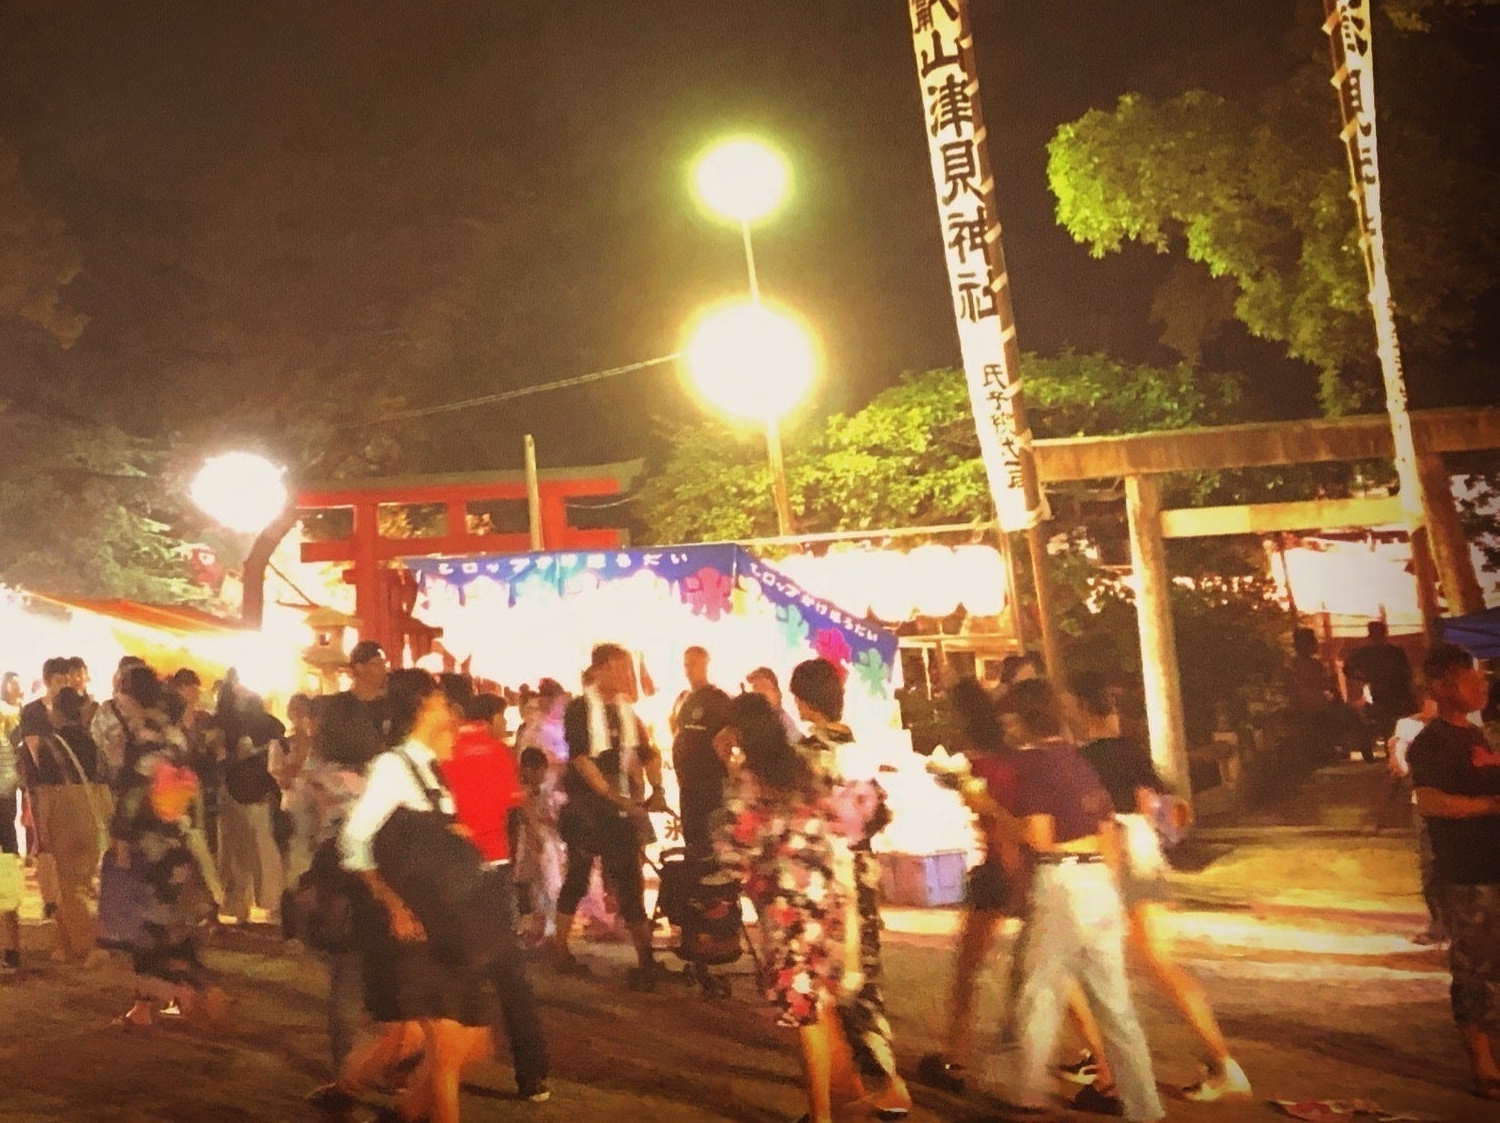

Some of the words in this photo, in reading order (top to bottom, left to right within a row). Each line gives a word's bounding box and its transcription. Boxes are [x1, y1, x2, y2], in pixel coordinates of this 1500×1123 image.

[438, 553, 688, 575] シロップだい
